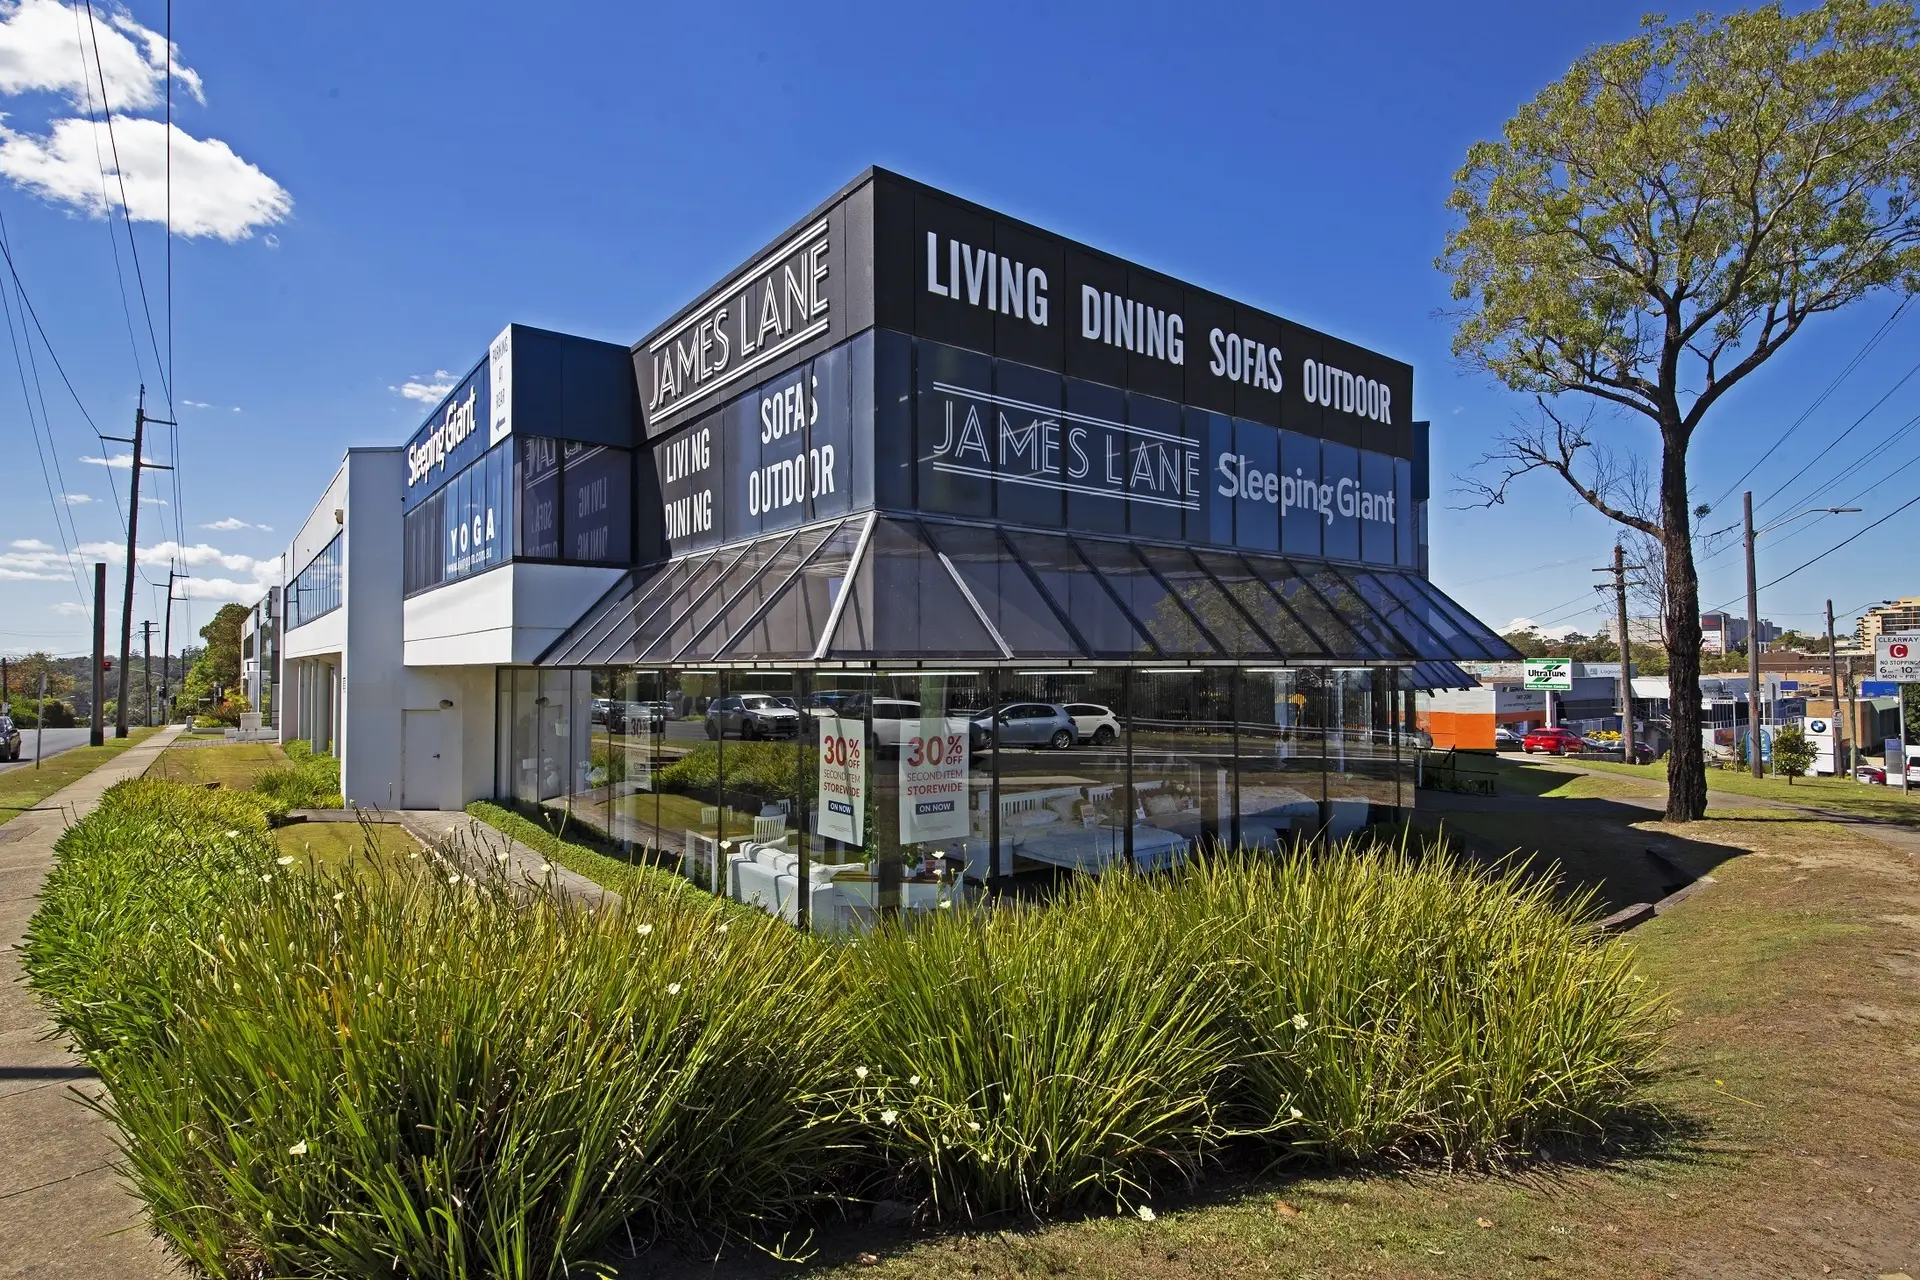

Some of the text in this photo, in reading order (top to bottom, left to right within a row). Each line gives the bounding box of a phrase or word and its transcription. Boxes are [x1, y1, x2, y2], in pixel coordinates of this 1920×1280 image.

[649, 238, 829, 410] JAMES LANE
[927, 231, 1392, 425] LIVING DINING SOFAS OUTDOOR
[761, 375, 818, 444] SOFAS
[666, 427, 710, 484] LIVING
[933, 400, 1200, 497] JAMES LANE
[749, 444, 835, 516] OUTDOOR
[1217, 452, 1396, 526] Sleeping Giant
[665, 489, 711, 540] DINING
[450, 508, 495, 557] YOGA
[823, 735, 860, 767] 30%
[848, 759, 860, 770] OFF
[907, 735, 963, 767] 30%
[945, 756, 962, 765] OFF
[823, 769, 860, 783] SECOND ITEM
[823, 782, 860, 798] STOREWIDE
[907, 769, 962, 783] SECOND ITEM
[907, 782, 962, 796] STOREWIDE
[830, 802, 851, 814] ON NOW
[919, 803, 951, 813] ON NOW
